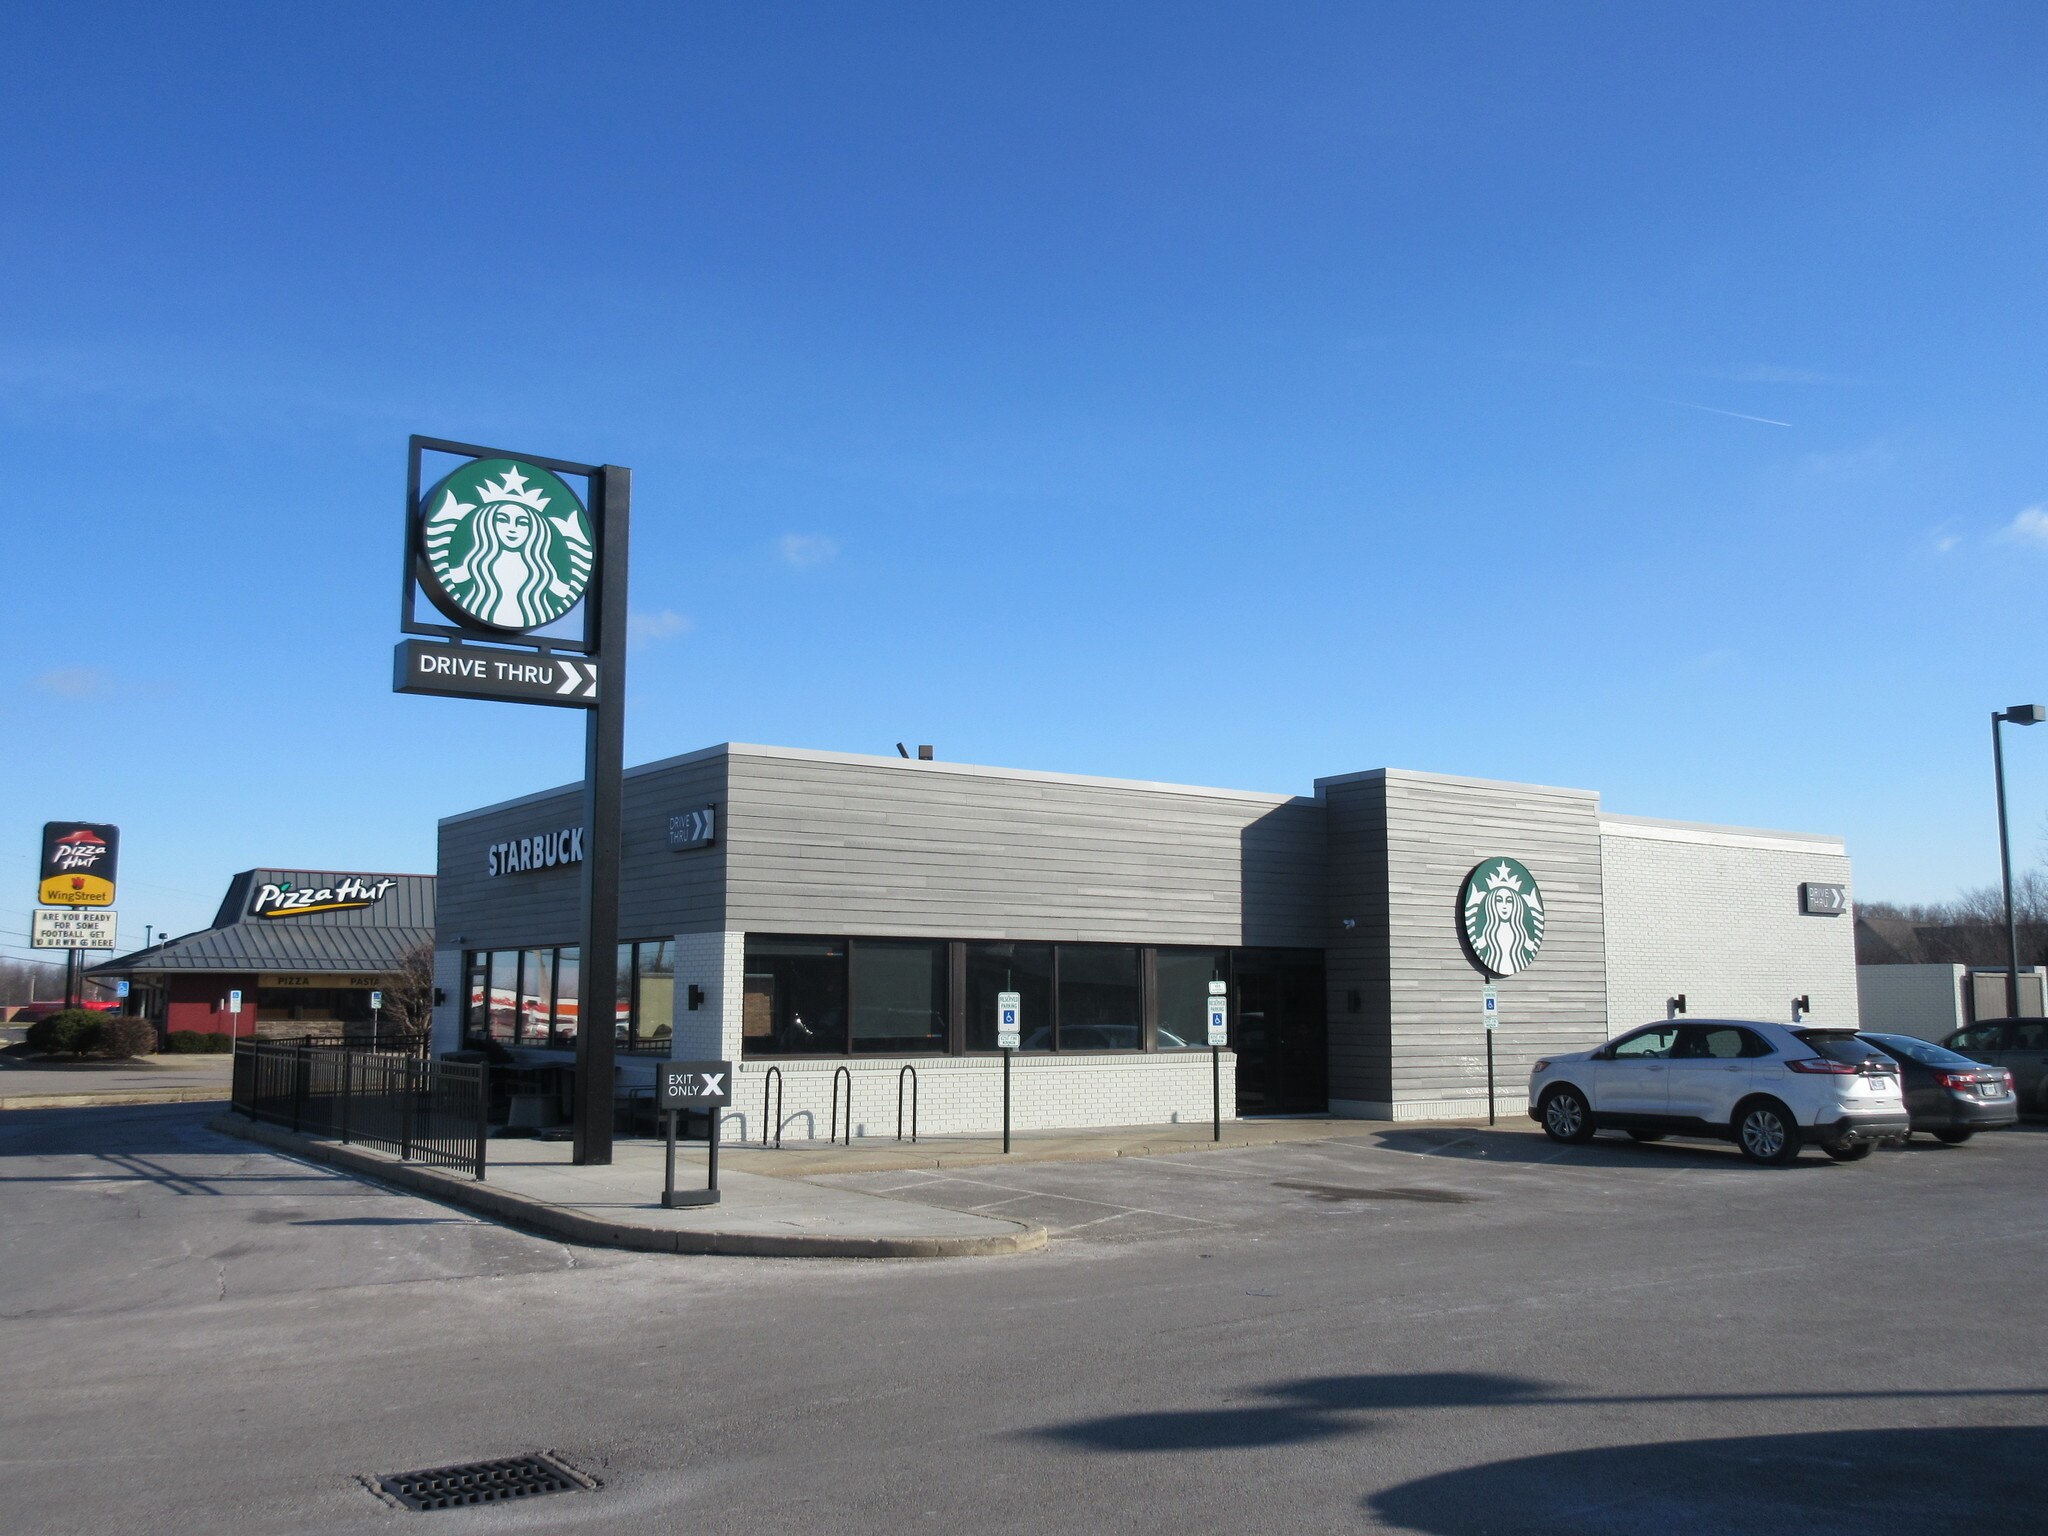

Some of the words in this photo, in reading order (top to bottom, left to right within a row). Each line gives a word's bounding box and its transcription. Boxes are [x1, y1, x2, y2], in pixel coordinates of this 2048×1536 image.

[420, 654, 487, 679] DRIVE
[494, 662, 553, 685] THRU
[669, 814, 690, 830] DRIVE
[669, 829, 689, 844] THRU
[53, 841, 107, 863] Pizza
[489, 827, 584, 877] STARBUCK
[62, 855, 101, 870] Hut
[48, 890, 106, 903] WingStreet
[255, 882, 333, 913] Pizza
[336, 876, 397, 902] Hut
[1809, 887, 1829, 898] DRIVE
[1810, 897, 1829, 908] THRU
[84, 914, 112, 922] READY
[76, 922, 99, 930] SOME
[41, 930, 84, 938] FOOTBALL
[91, 939, 113, 947] HERE
[278, 977, 309, 985] PIZZA
[668, 1074, 694, 1085] EXIT
[668, 1085, 700, 1097] ONLY
